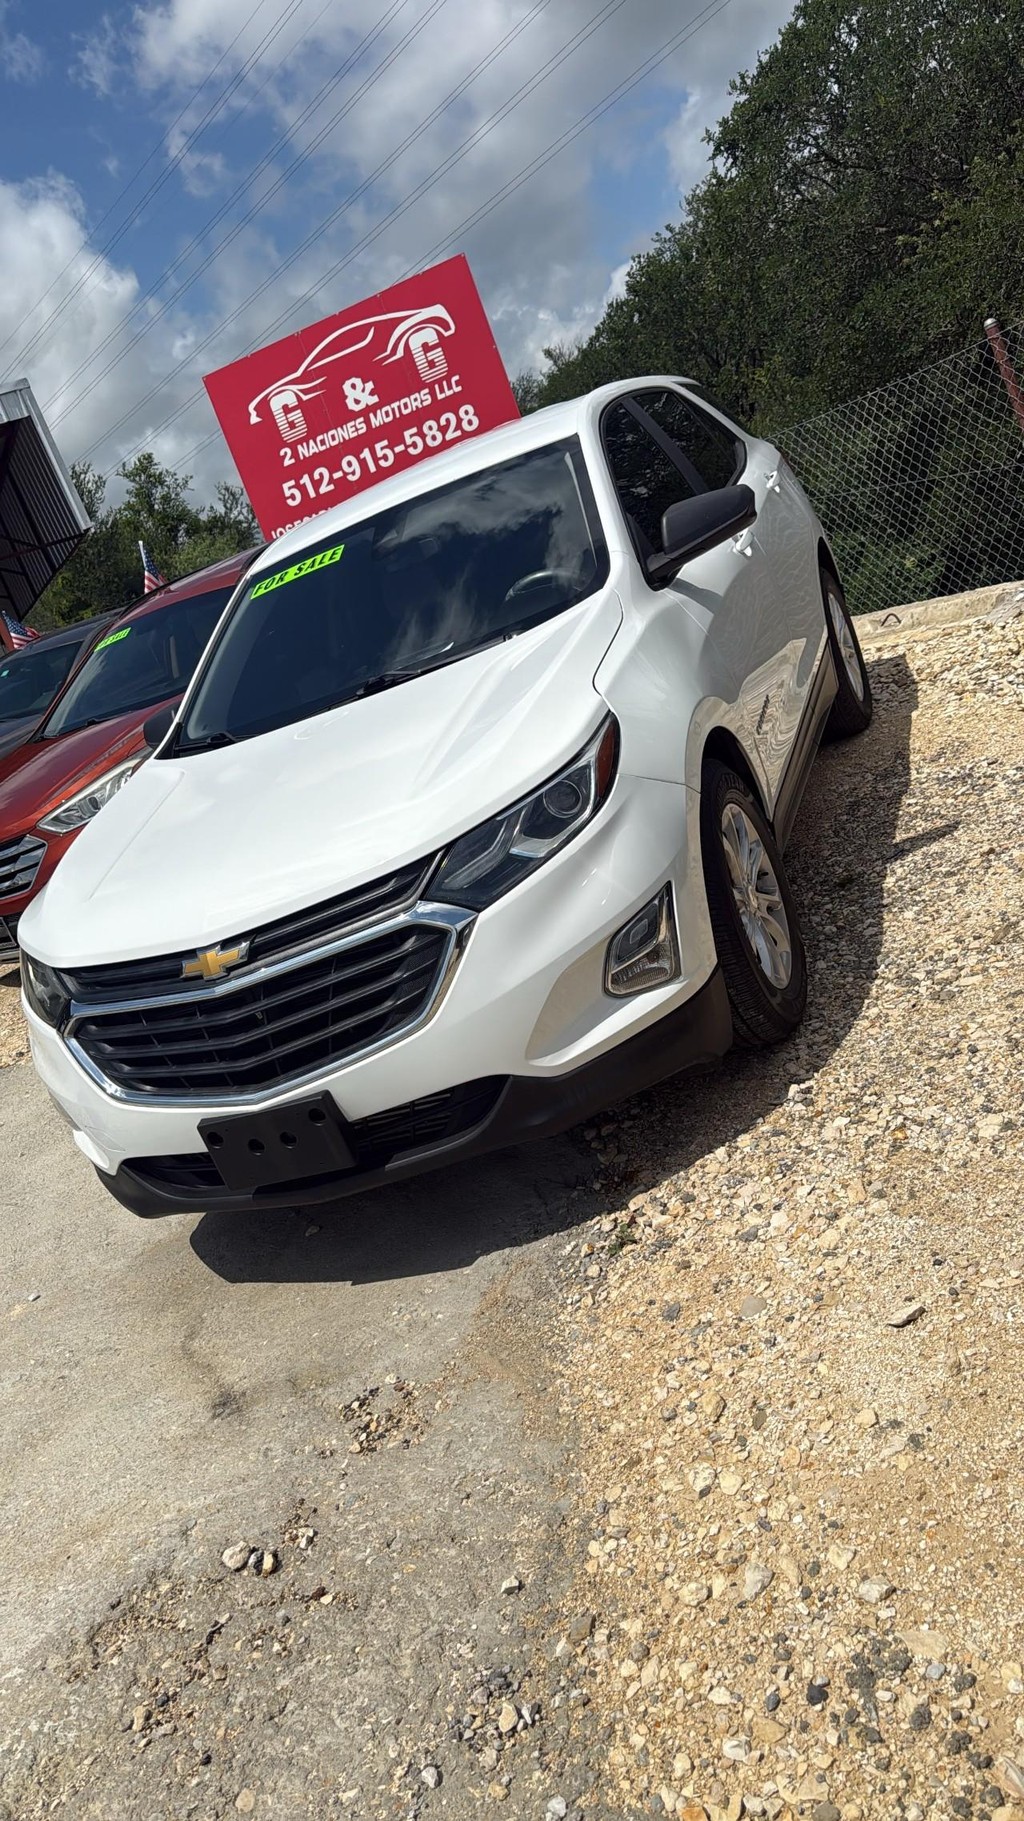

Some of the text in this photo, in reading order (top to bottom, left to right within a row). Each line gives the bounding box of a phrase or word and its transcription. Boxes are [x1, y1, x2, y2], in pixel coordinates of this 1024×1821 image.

[279, 375, 463, 467] 2 NACIONES MOTORS LLC
[342, 376, 380, 412] &
[282, 404, 480, 507] 512-915-5828
[253, 547, 342, 596] FOR SALE
